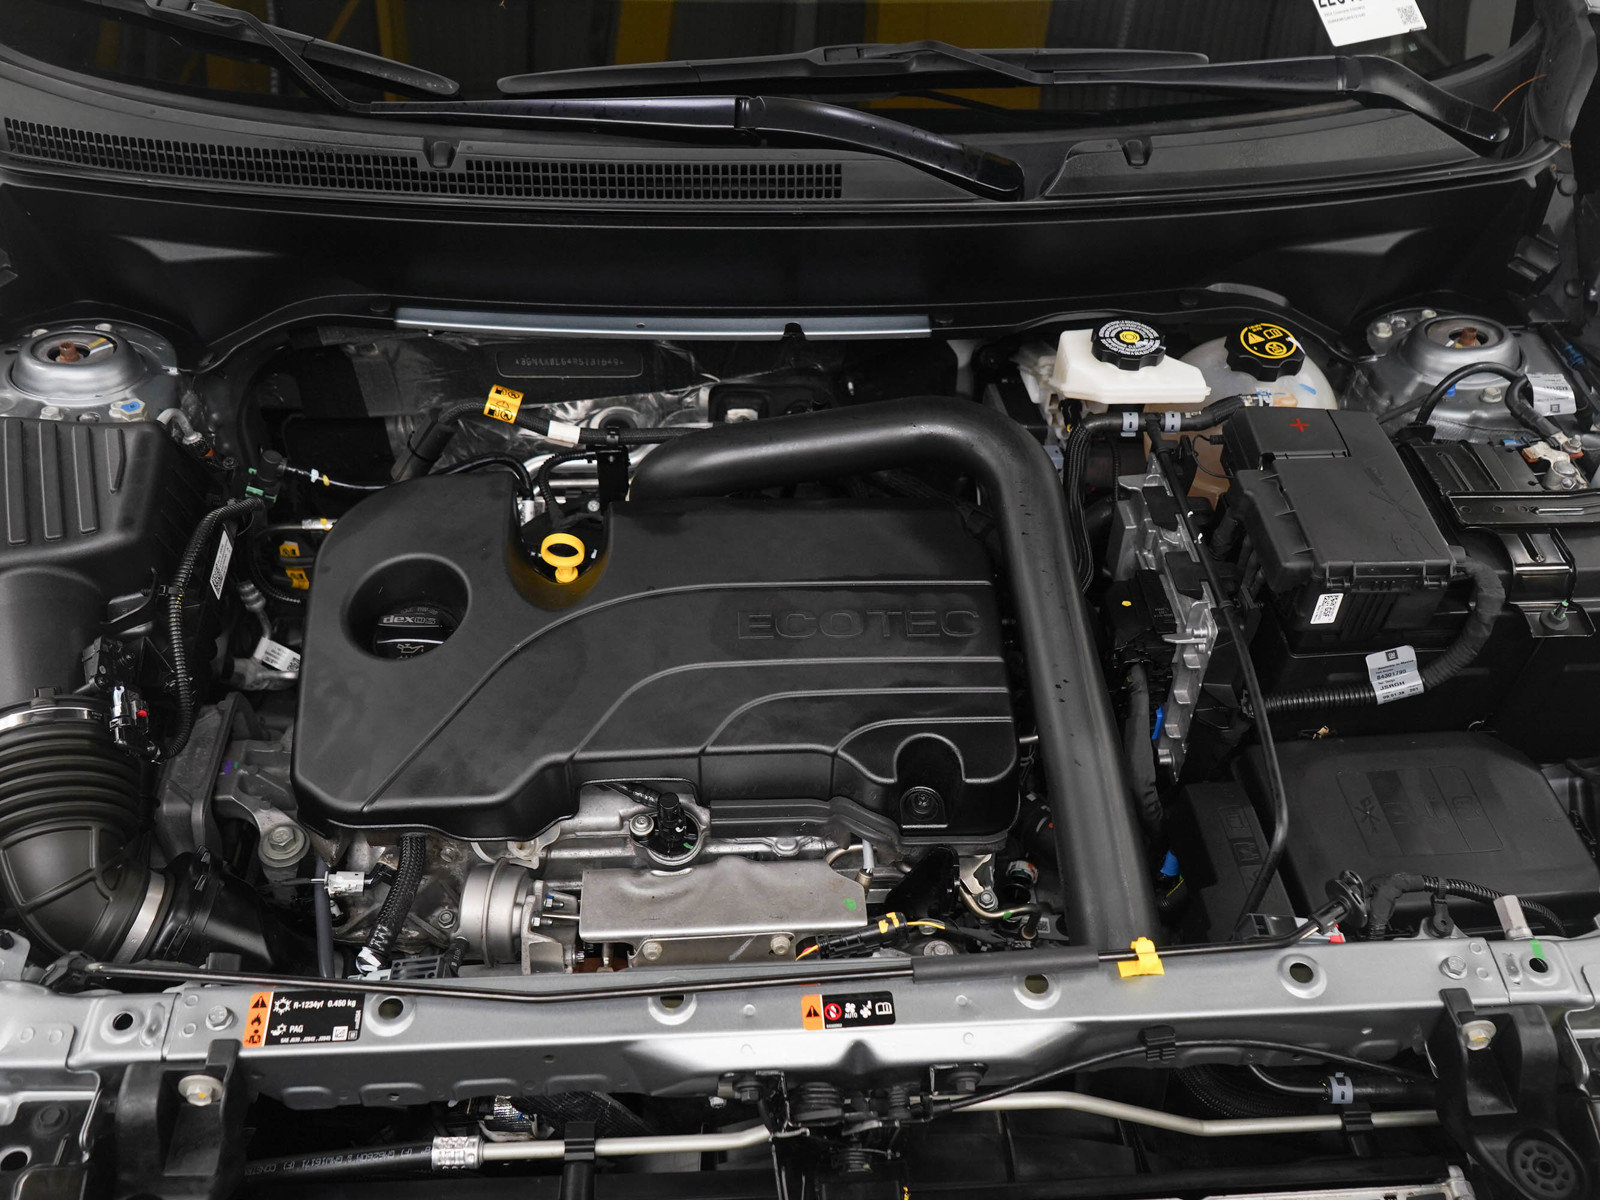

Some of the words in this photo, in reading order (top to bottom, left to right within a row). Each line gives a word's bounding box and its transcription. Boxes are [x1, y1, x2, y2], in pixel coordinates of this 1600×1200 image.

[737, 610, 981, 640] ECOTEC
[347, 999, 356, 1007] kg
[289, 1025, 304, 1034] PAG
